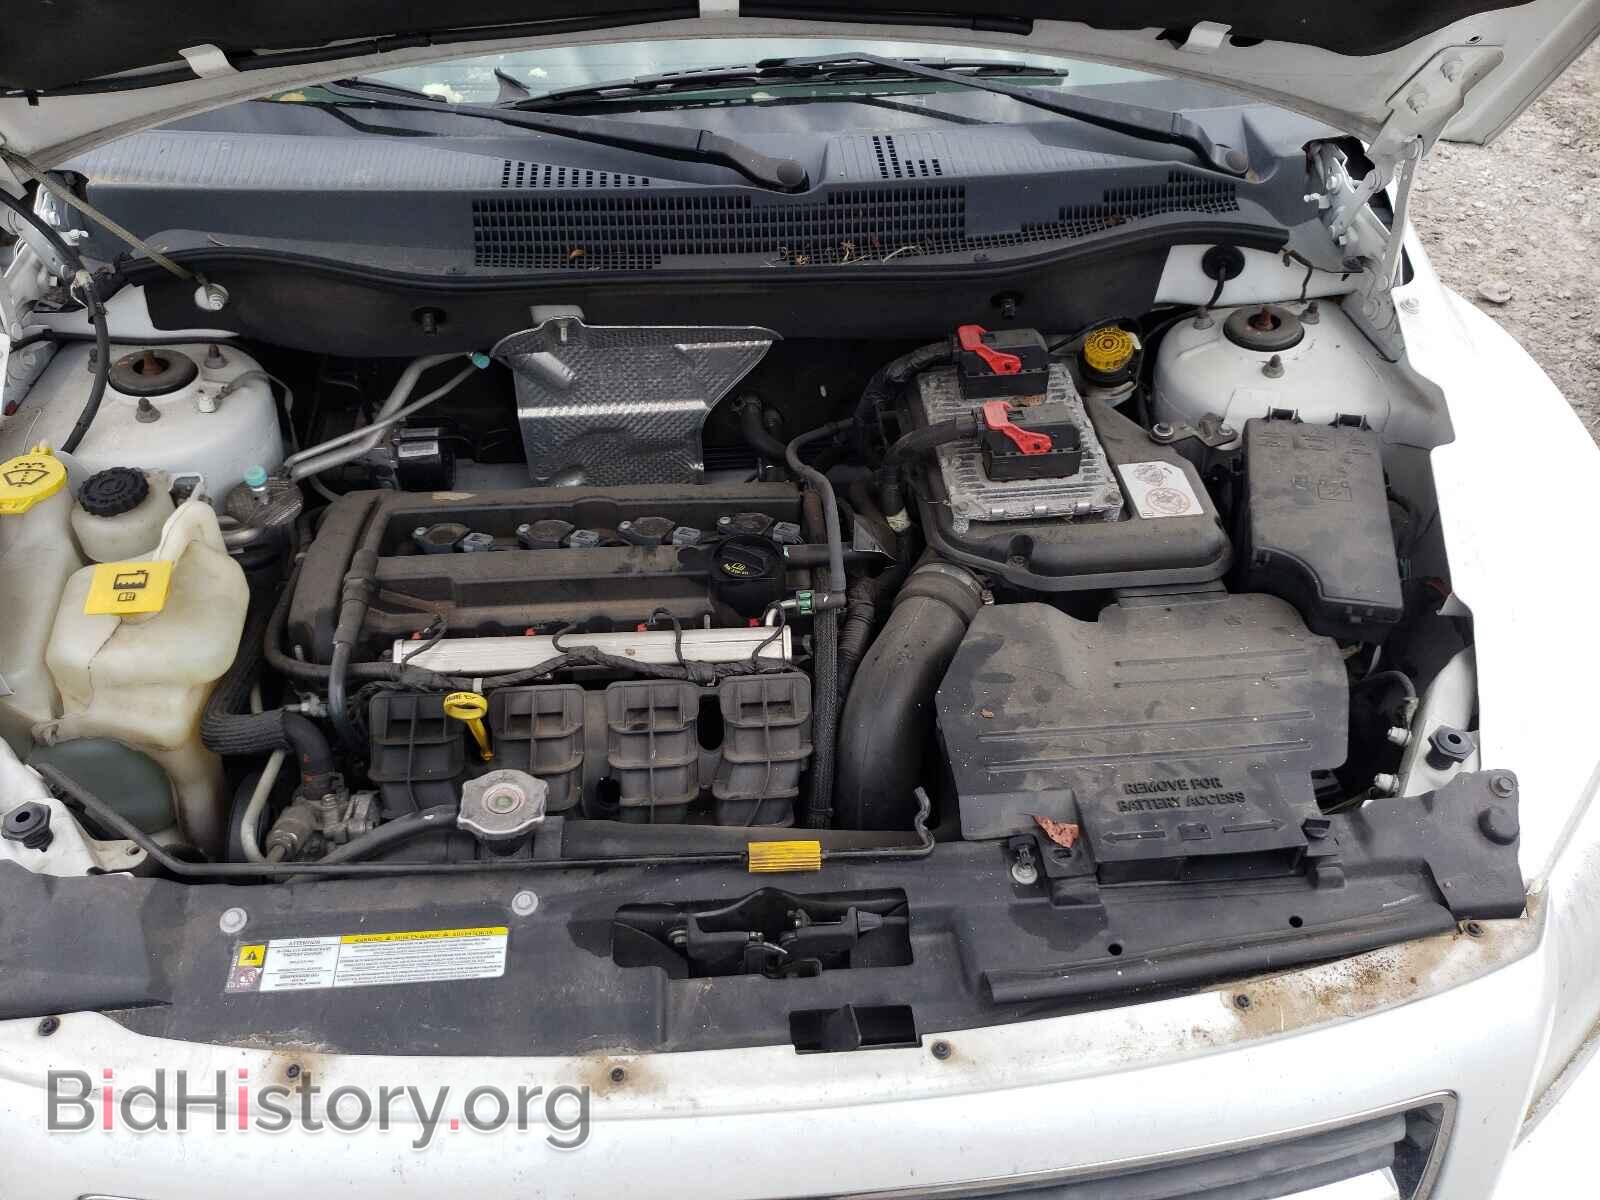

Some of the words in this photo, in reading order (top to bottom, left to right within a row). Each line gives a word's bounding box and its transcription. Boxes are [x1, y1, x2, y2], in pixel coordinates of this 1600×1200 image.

[1124, 779, 1189, 795] REMOVE
[1190, 777, 1223, 789] FOR
[1117, 795, 1181, 812] BATTERY
[1187, 791, 1247, 807] ACCESS
